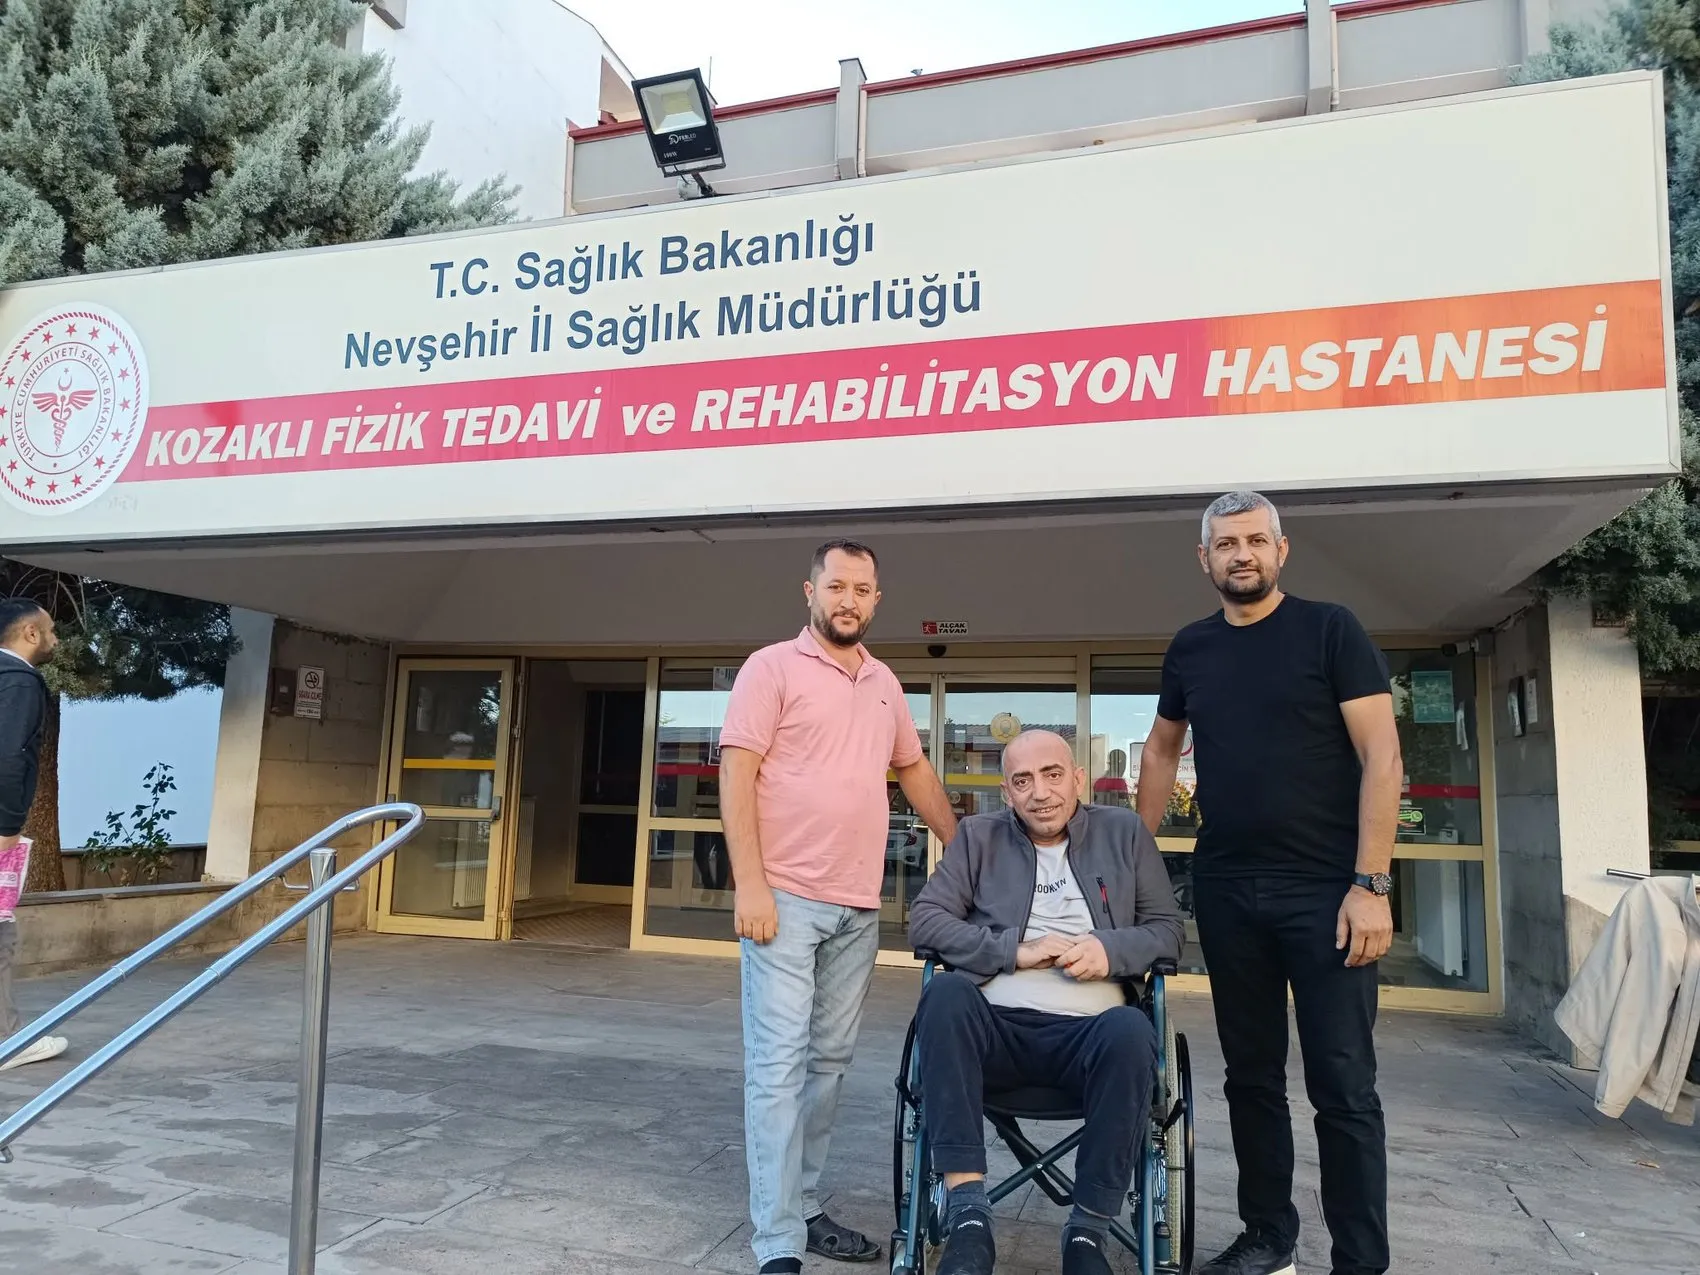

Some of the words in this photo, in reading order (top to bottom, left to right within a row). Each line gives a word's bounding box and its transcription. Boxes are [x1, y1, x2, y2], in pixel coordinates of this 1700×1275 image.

[430, 257, 499, 299] T.C.
[514, 241, 644, 295] Sağlık
[659, 213, 875, 277] Bakanlığı
[344, 319, 518, 373] Nevşehir
[530, 304, 552, 353] İl
[567, 301, 699, 356] Sağlık
[718, 271, 980, 336] Müdürlüğü
[16, 346, 79, 406] CUMHURİYETİ
[144, 419, 314, 468] KOZAKLI
[320, 401, 431, 456] FİZİK
[442, 386, 602, 448] TEDAVİ
[622, 402, 676, 437] ve
[690, 353, 1178, 432] REHABİLİTASYON
[1202, 303, 1609, 397] HASTANESİ
[1035, 878, 1067, 894] OOKLYN
